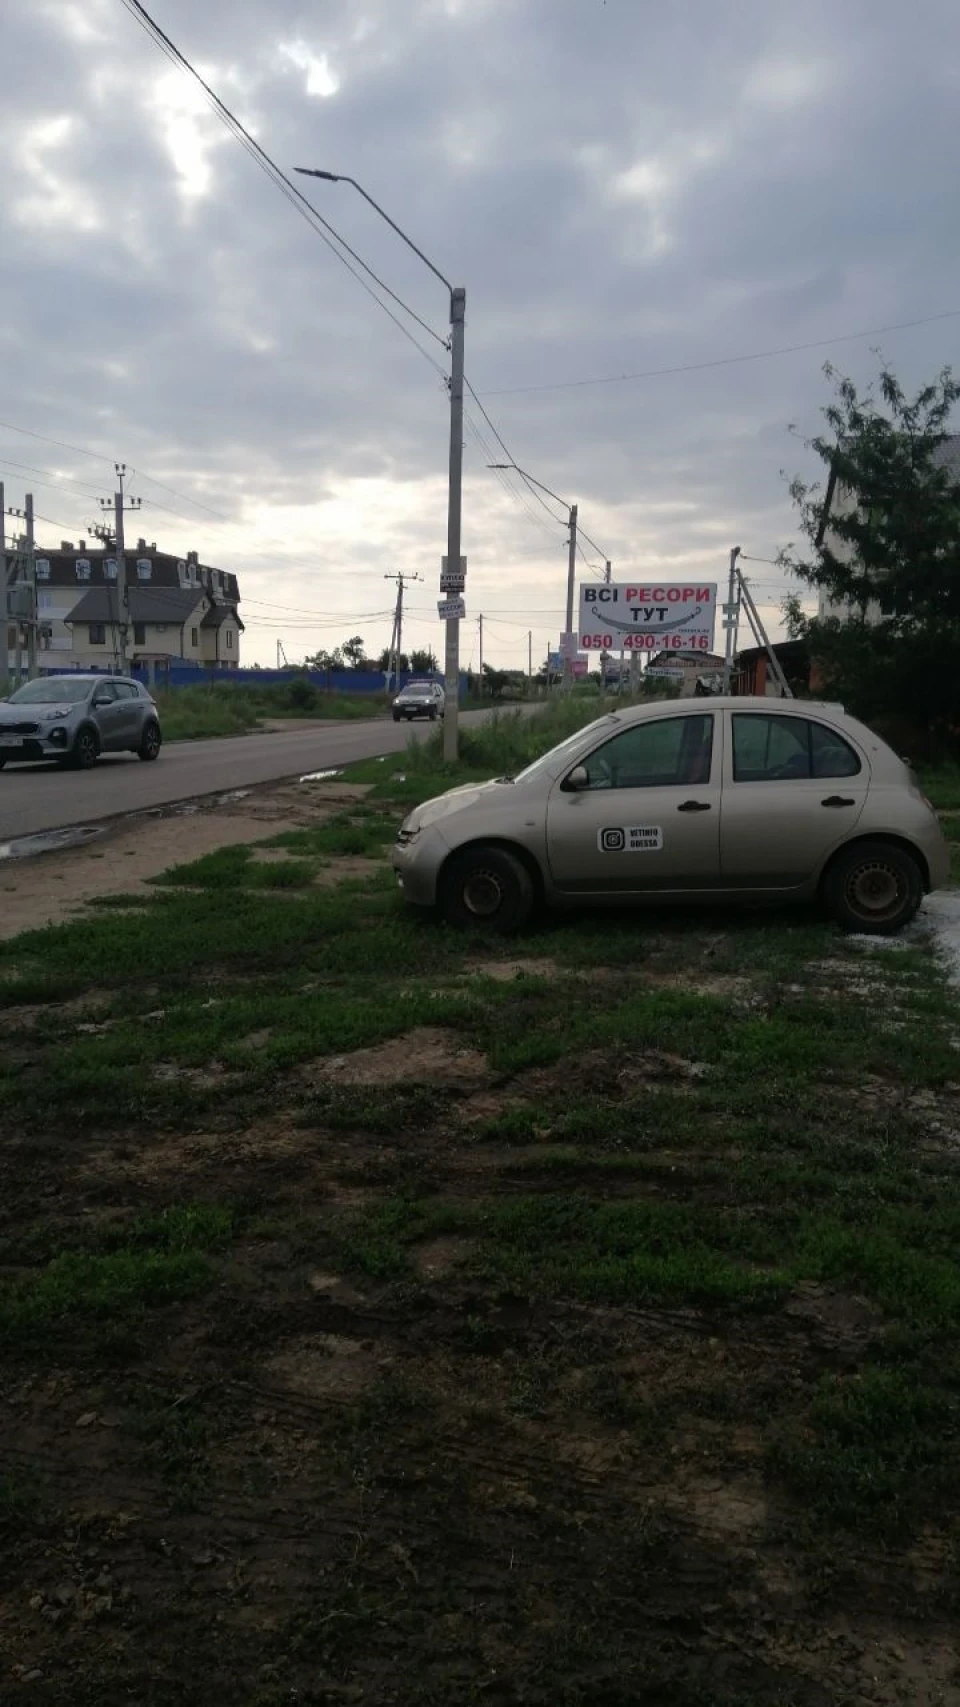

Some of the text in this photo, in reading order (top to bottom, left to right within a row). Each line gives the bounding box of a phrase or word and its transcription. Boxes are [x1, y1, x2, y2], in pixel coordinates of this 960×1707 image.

[584, 588, 710, 602] ВСІ РЕСОРИ
[630, 607, 669, 621] ТУТ
[582, 634, 709, 649] 050 490-16-16
[630, 839, 658, 848] ODESSA
